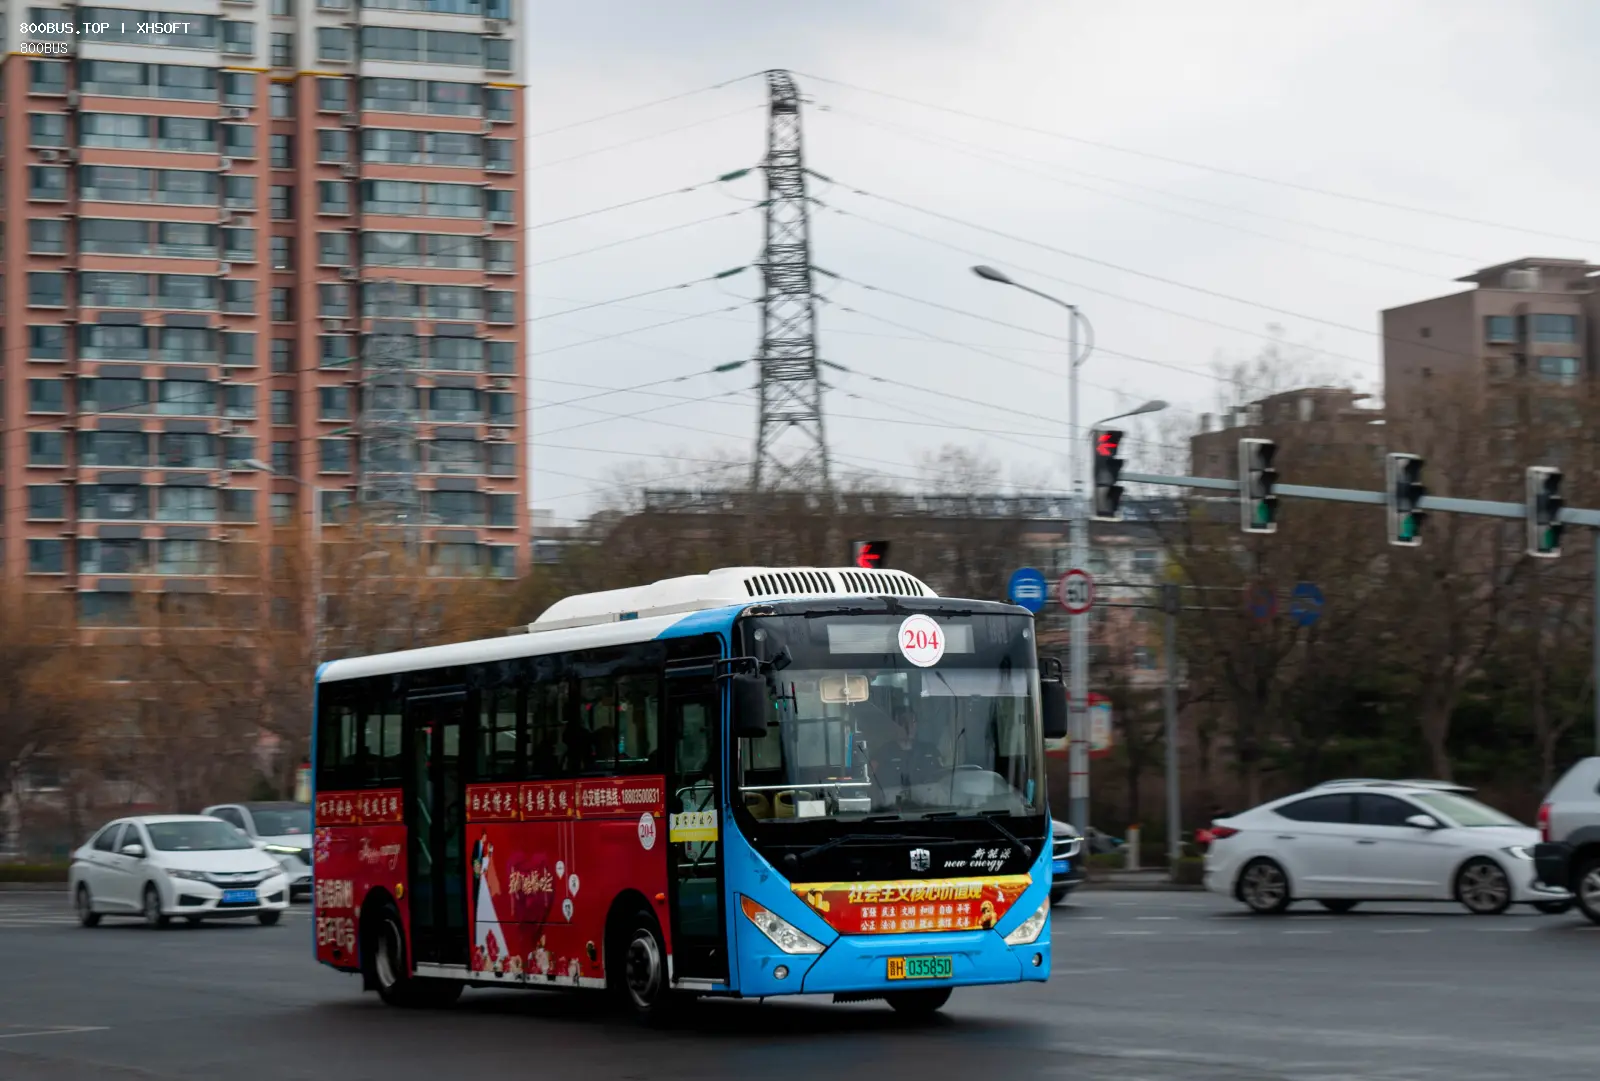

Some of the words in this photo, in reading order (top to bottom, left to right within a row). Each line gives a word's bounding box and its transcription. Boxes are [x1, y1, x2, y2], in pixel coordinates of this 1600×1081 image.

[904, 629, 939, 650] 204
[640, 823, 654, 838] 204
[972, 848, 1012, 859] 新能源
[944, 860, 968, 868] new
[969, 860, 1004, 872] energy
[848, 883, 983, 903] 社会主义核心价值观
